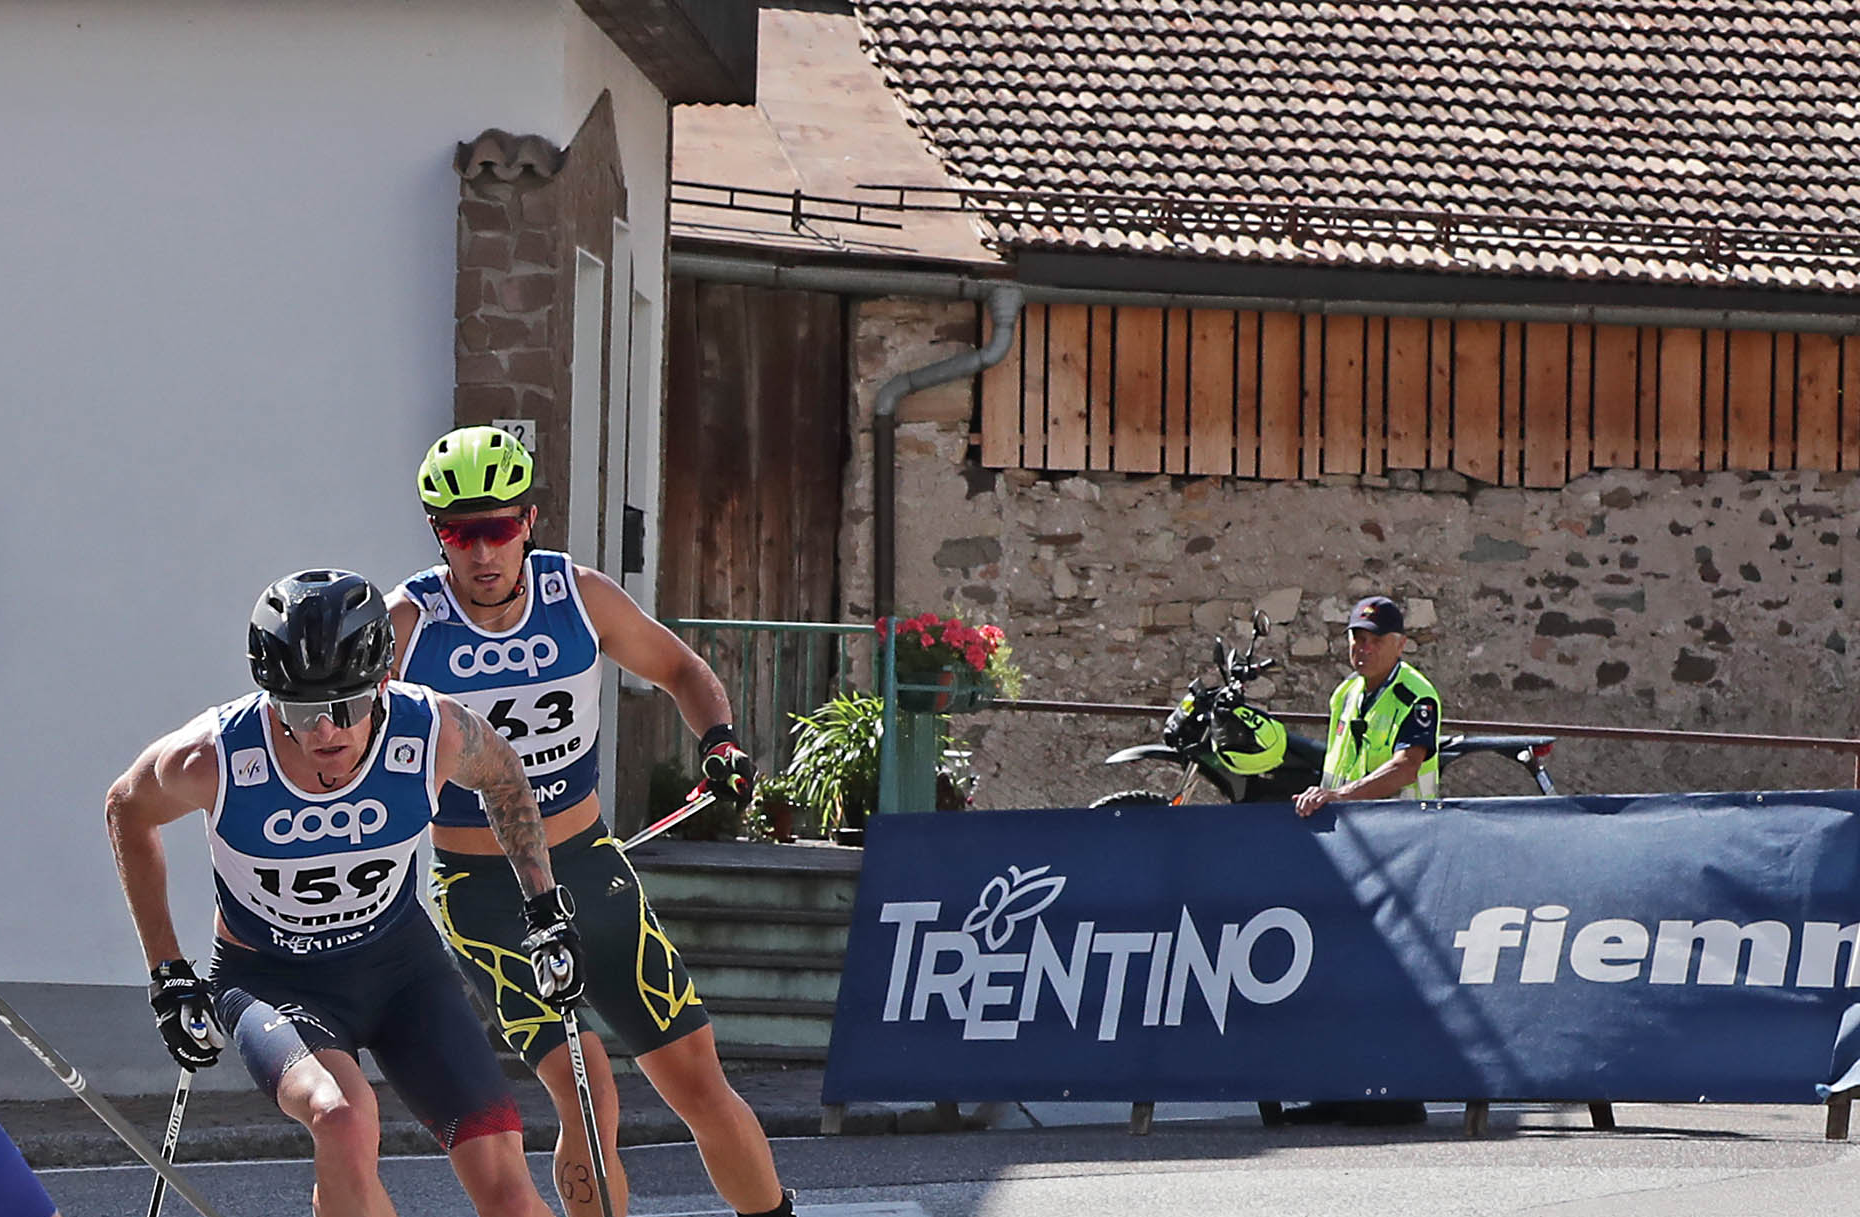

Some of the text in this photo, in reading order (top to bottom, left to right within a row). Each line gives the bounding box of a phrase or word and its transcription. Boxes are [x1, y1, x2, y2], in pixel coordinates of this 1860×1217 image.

[448, 633, 559, 679] coop
[464, 690, 574, 741] 63
[263, 798, 389, 844] coop
[253, 858, 398, 905] 159
[162, 978, 196, 990] SWIX
[879, 901, 1314, 1041] TRENTINO
